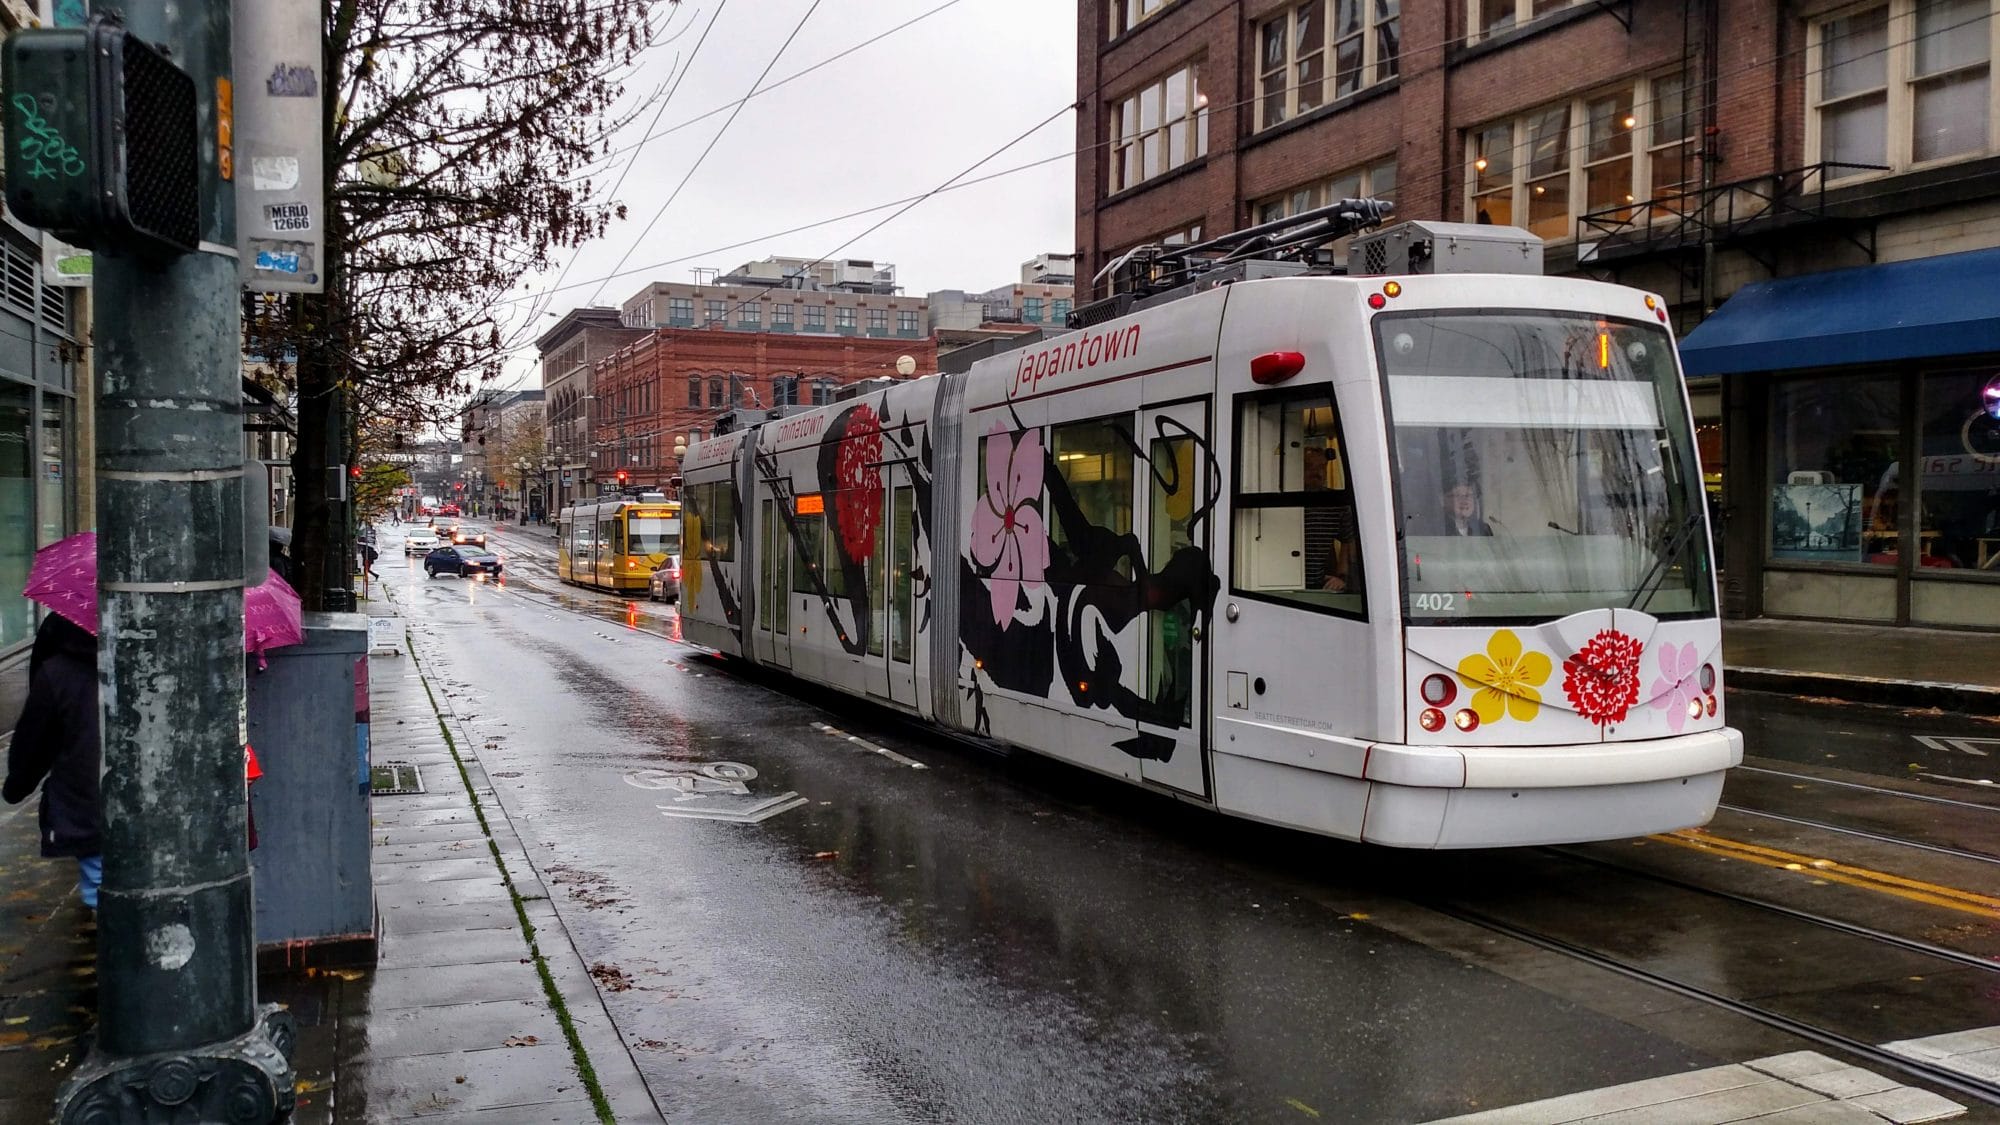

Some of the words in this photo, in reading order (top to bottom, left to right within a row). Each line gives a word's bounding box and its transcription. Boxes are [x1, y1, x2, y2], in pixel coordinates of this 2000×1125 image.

[271, 205, 308, 218] MERLO
[273, 218, 310, 230] 12666
[1010, 323, 1140, 397] japantown
[1415, 593, 1455, 611] 402
[1254, 711, 1334, 730] SEATTLESTREETCAR.COM
